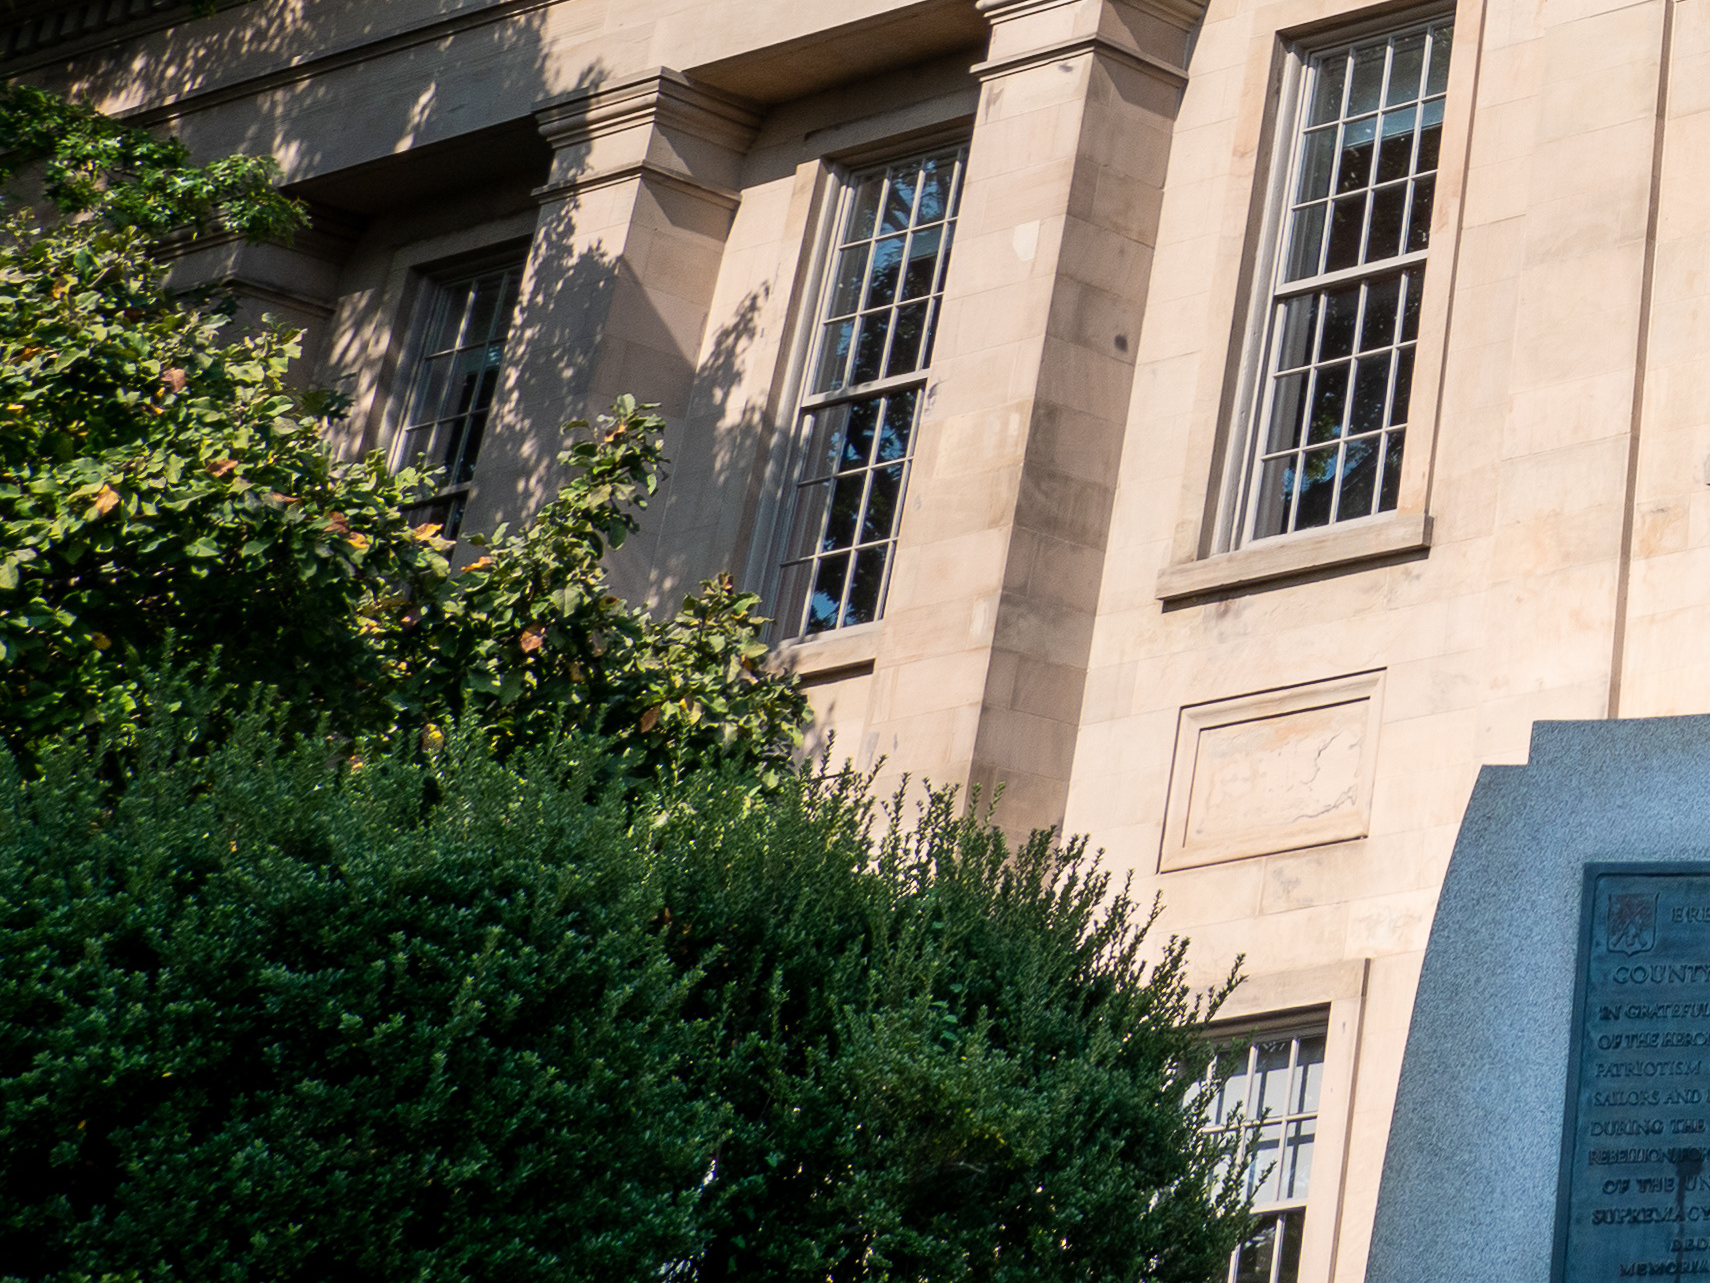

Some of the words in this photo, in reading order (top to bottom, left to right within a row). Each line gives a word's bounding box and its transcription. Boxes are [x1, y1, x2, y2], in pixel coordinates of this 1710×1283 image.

[1599, 1005, 1621, 1020] IN
[1624, 1003, 1710, 1019] GRATEFUL
[1597, 1034, 1621, 1050] OF
[1625, 1032, 1659, 1047] THE
[1596, 1060, 1701, 1078] PATRIOTISM
[1593, 1090, 1660, 1107] SAILORS
[1663, 1089, 1701, 1104] AND
[1590, 1119, 1663, 1137] DURING
[1671, 1118, 1705, 1134] THE
[1602, 1178, 1630, 1194] OF
[1637, 1177, 1674, 1192] THE
